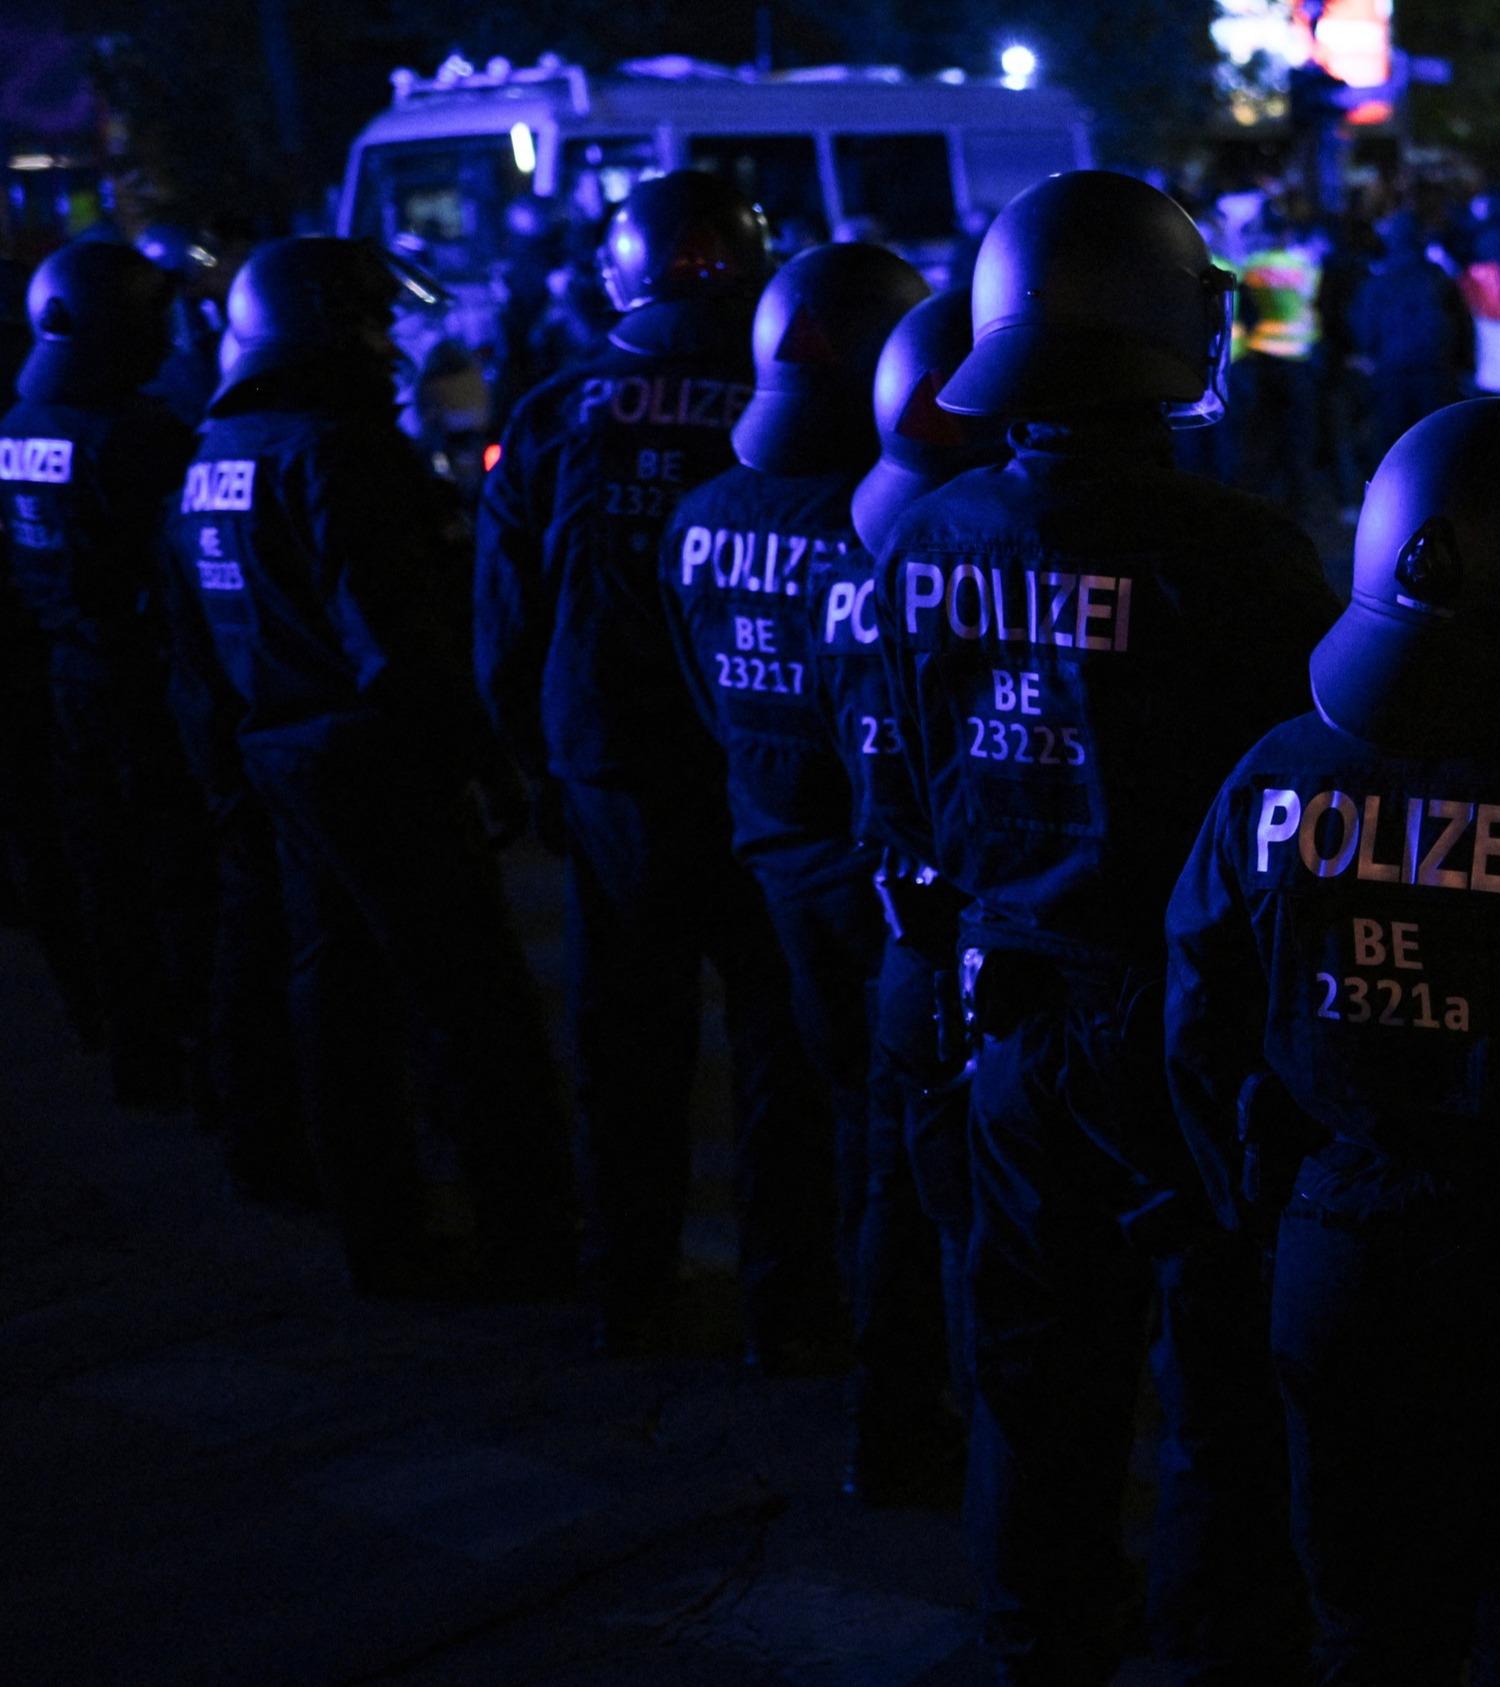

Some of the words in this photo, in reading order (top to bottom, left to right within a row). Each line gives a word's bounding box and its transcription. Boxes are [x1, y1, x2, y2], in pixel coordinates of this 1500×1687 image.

[579, 374, 751, 428] POLIZE
[905, 561, 1133, 653] POLIZEI
[734, 614, 777, 655] BE
[714, 652, 804, 695] 23217
[993, 669, 1042, 716] BE
[967, 716, 1086, 766] 23225
[1352, 917, 1425, 971] BE
[1315, 972, 1471, 1033] 2321a
